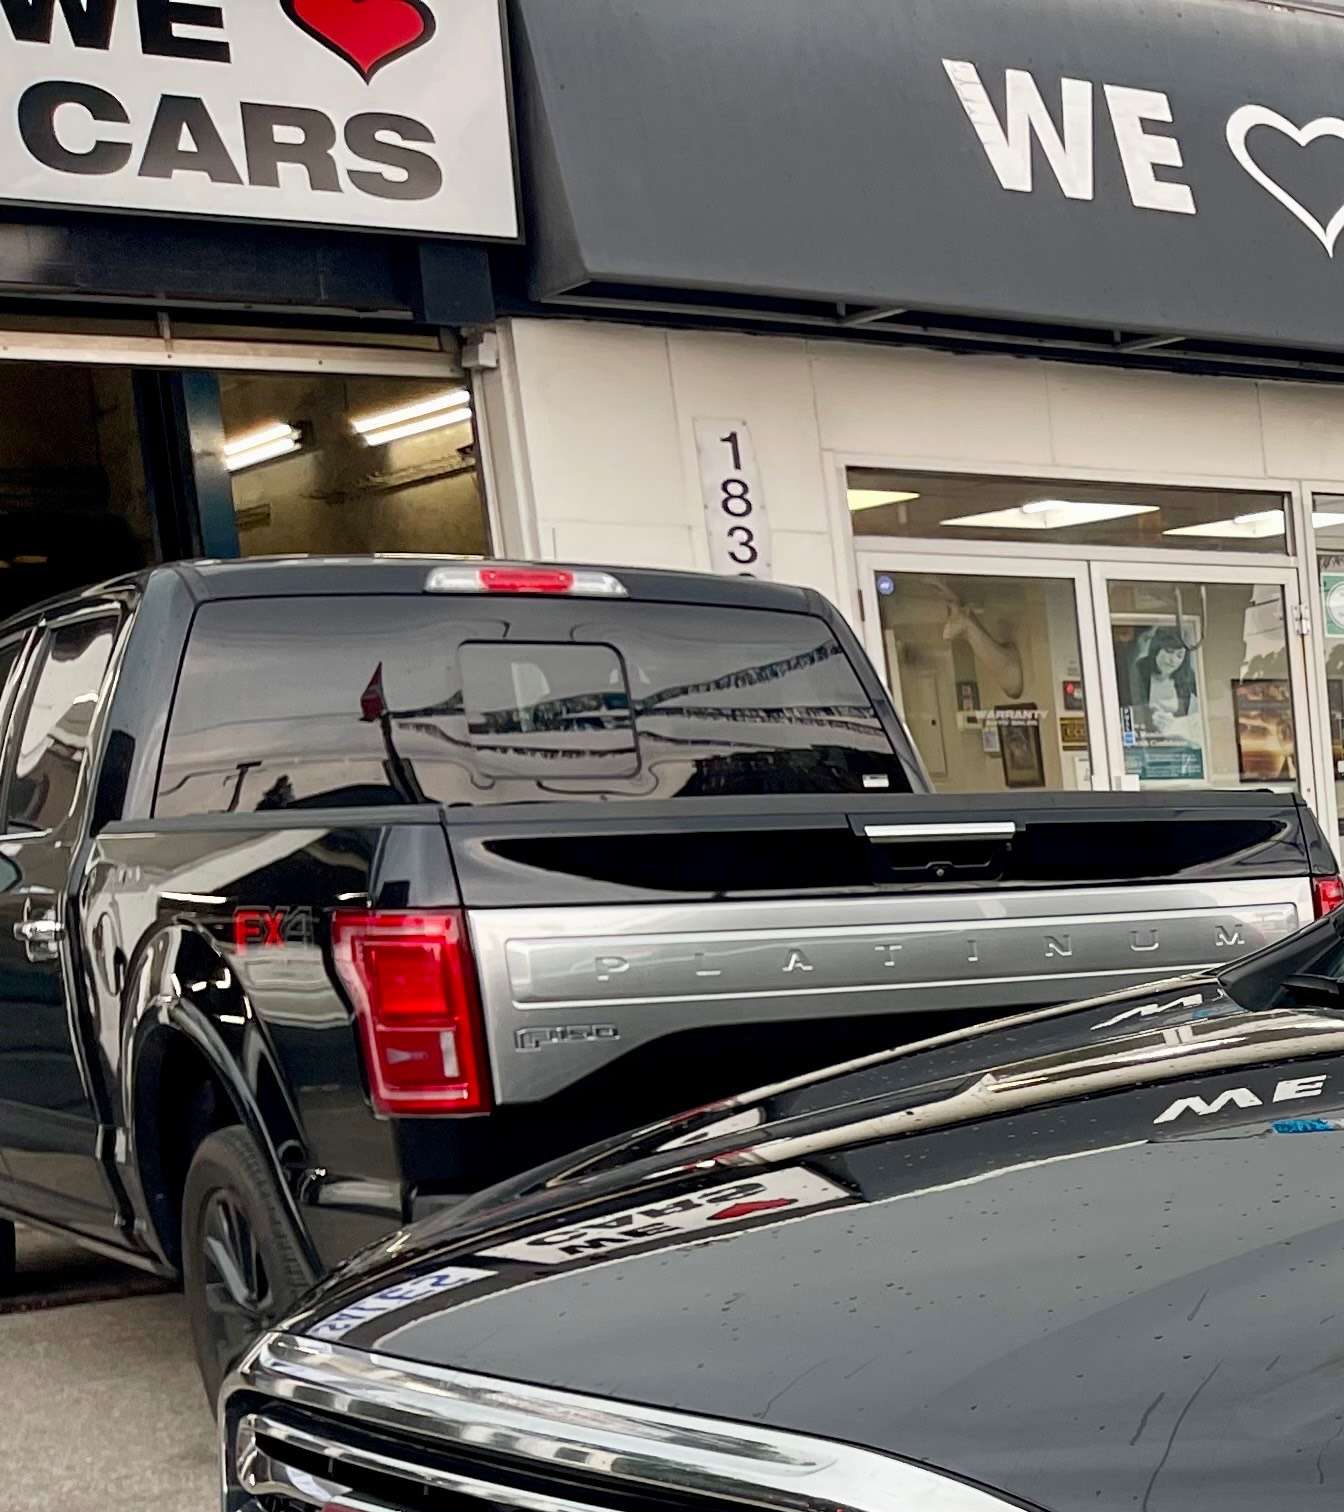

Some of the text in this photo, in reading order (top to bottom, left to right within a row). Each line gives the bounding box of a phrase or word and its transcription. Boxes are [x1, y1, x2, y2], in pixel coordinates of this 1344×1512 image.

[17, 80, 443, 200] CARS
[942, 58, 1196, 215] WE
[720, 431, 758, 577] 183
[233, 905, 315, 956] FX4
[595, 923, 1247, 982] PLATINUM
